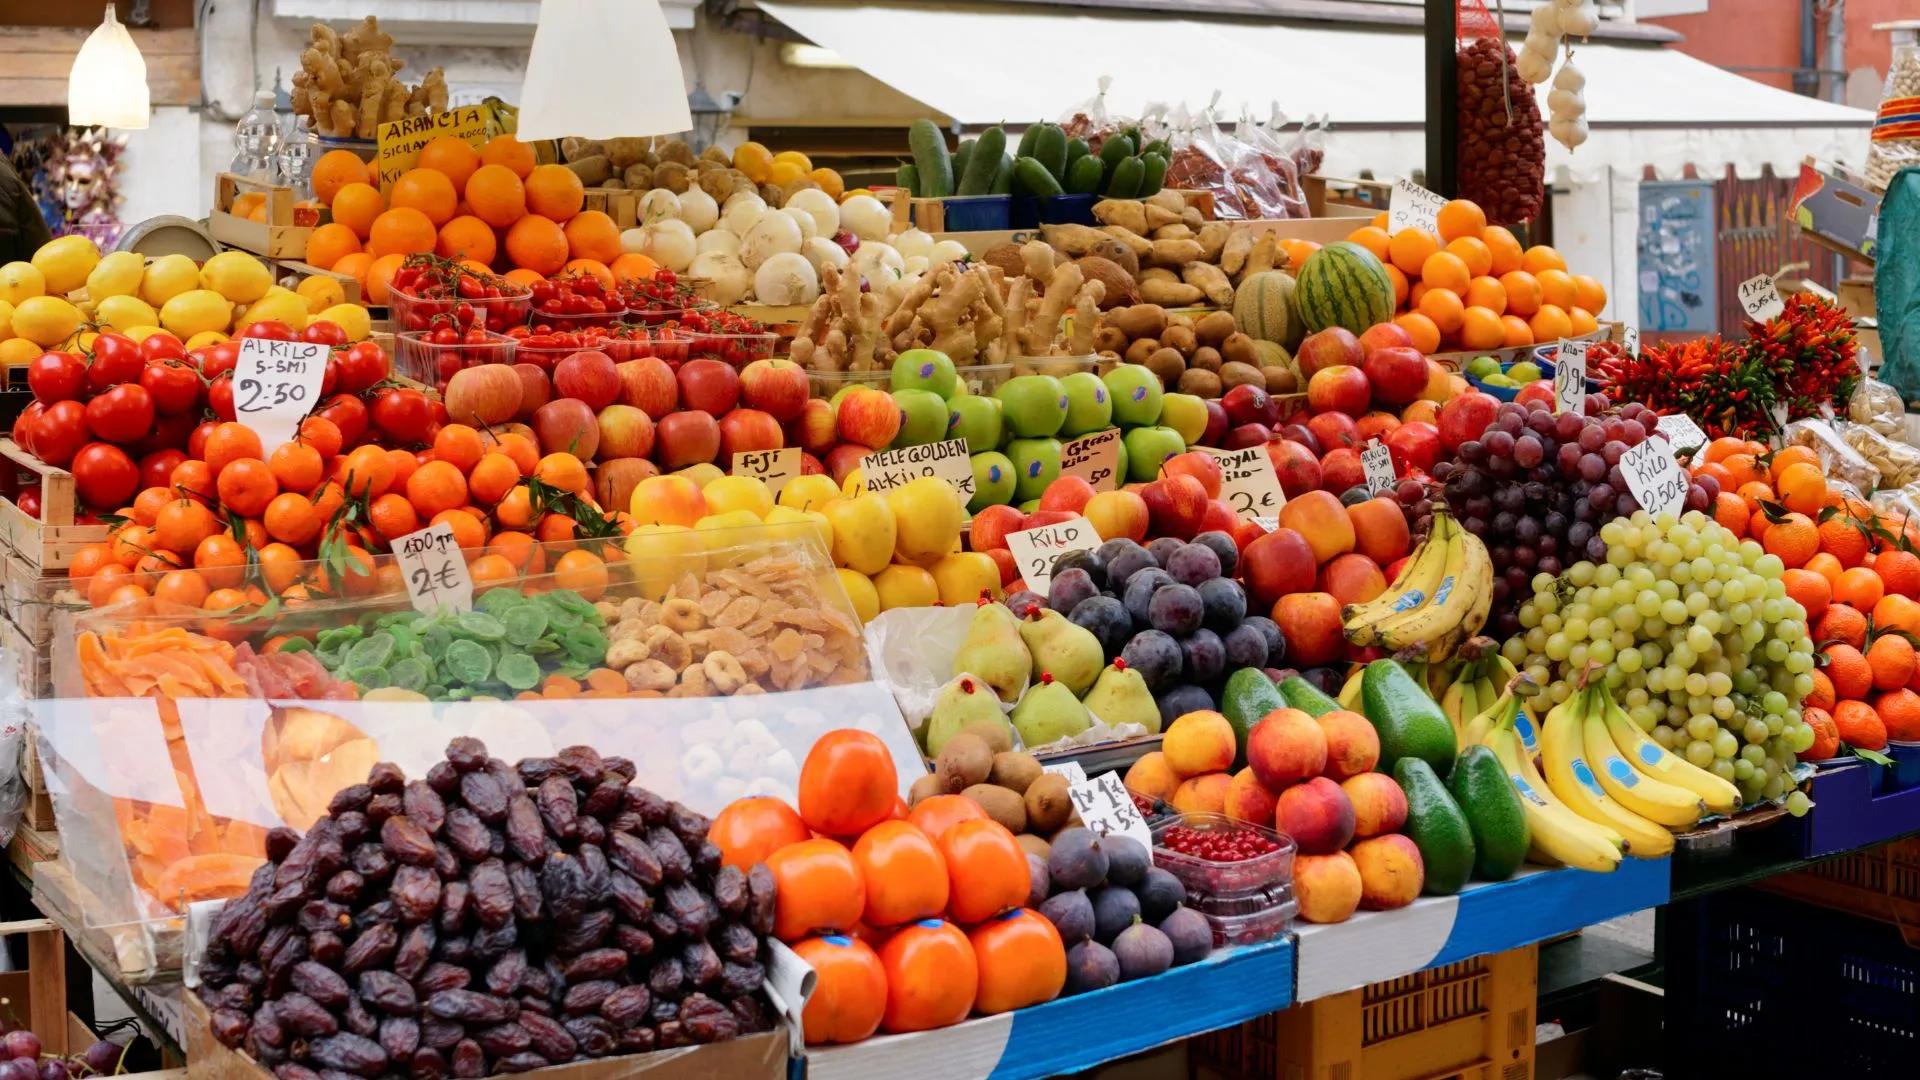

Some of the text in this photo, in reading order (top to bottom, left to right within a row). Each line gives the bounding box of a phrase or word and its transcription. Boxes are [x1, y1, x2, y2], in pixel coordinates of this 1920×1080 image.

[385, 108, 480, 141] ARANCIA
[865, 438, 967, 468] MELE GOLDEN
[1625, 440, 1655, 466] UVA
[1636, 456, 1667, 484] KiLO
[1028, 528, 1079, 548] KiLO
